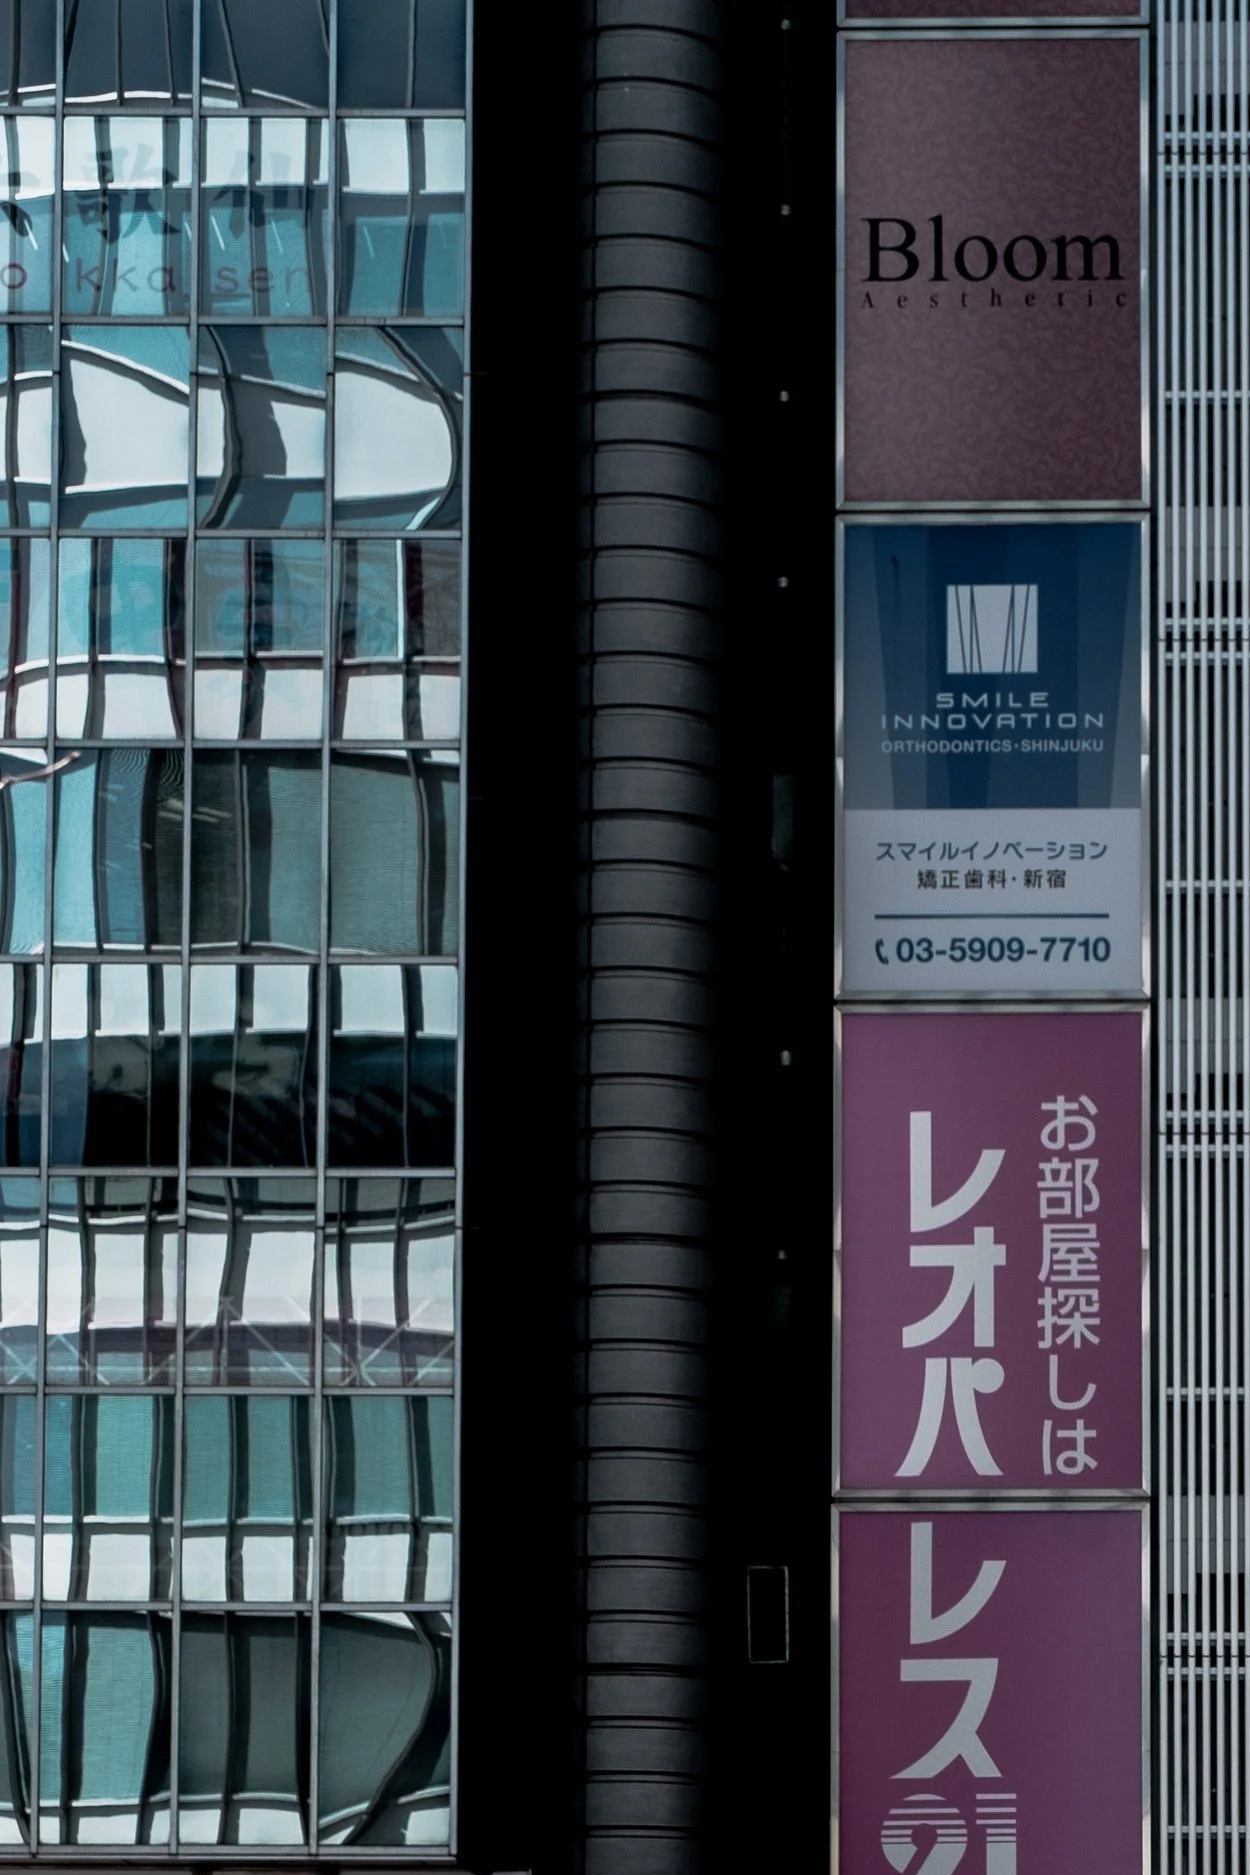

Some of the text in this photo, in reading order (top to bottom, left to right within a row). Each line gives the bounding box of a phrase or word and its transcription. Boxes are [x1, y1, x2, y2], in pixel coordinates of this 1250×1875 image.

[860, 213, 1126, 282] Bloom
[860, 288, 1128, 309] Aesthetic
[936, 692, 1049, 708] SMILE
[881, 713, 1104, 729] INNOVATION
[876, 841, 1108, 861] スマイルイノベーション
[917, 869, 1067, 889] 矯正歯科・新宿
[896, 937, 1111, 962] 03-5909-7710
[1037, 1094, 1102, 1476] お部屋探しは
